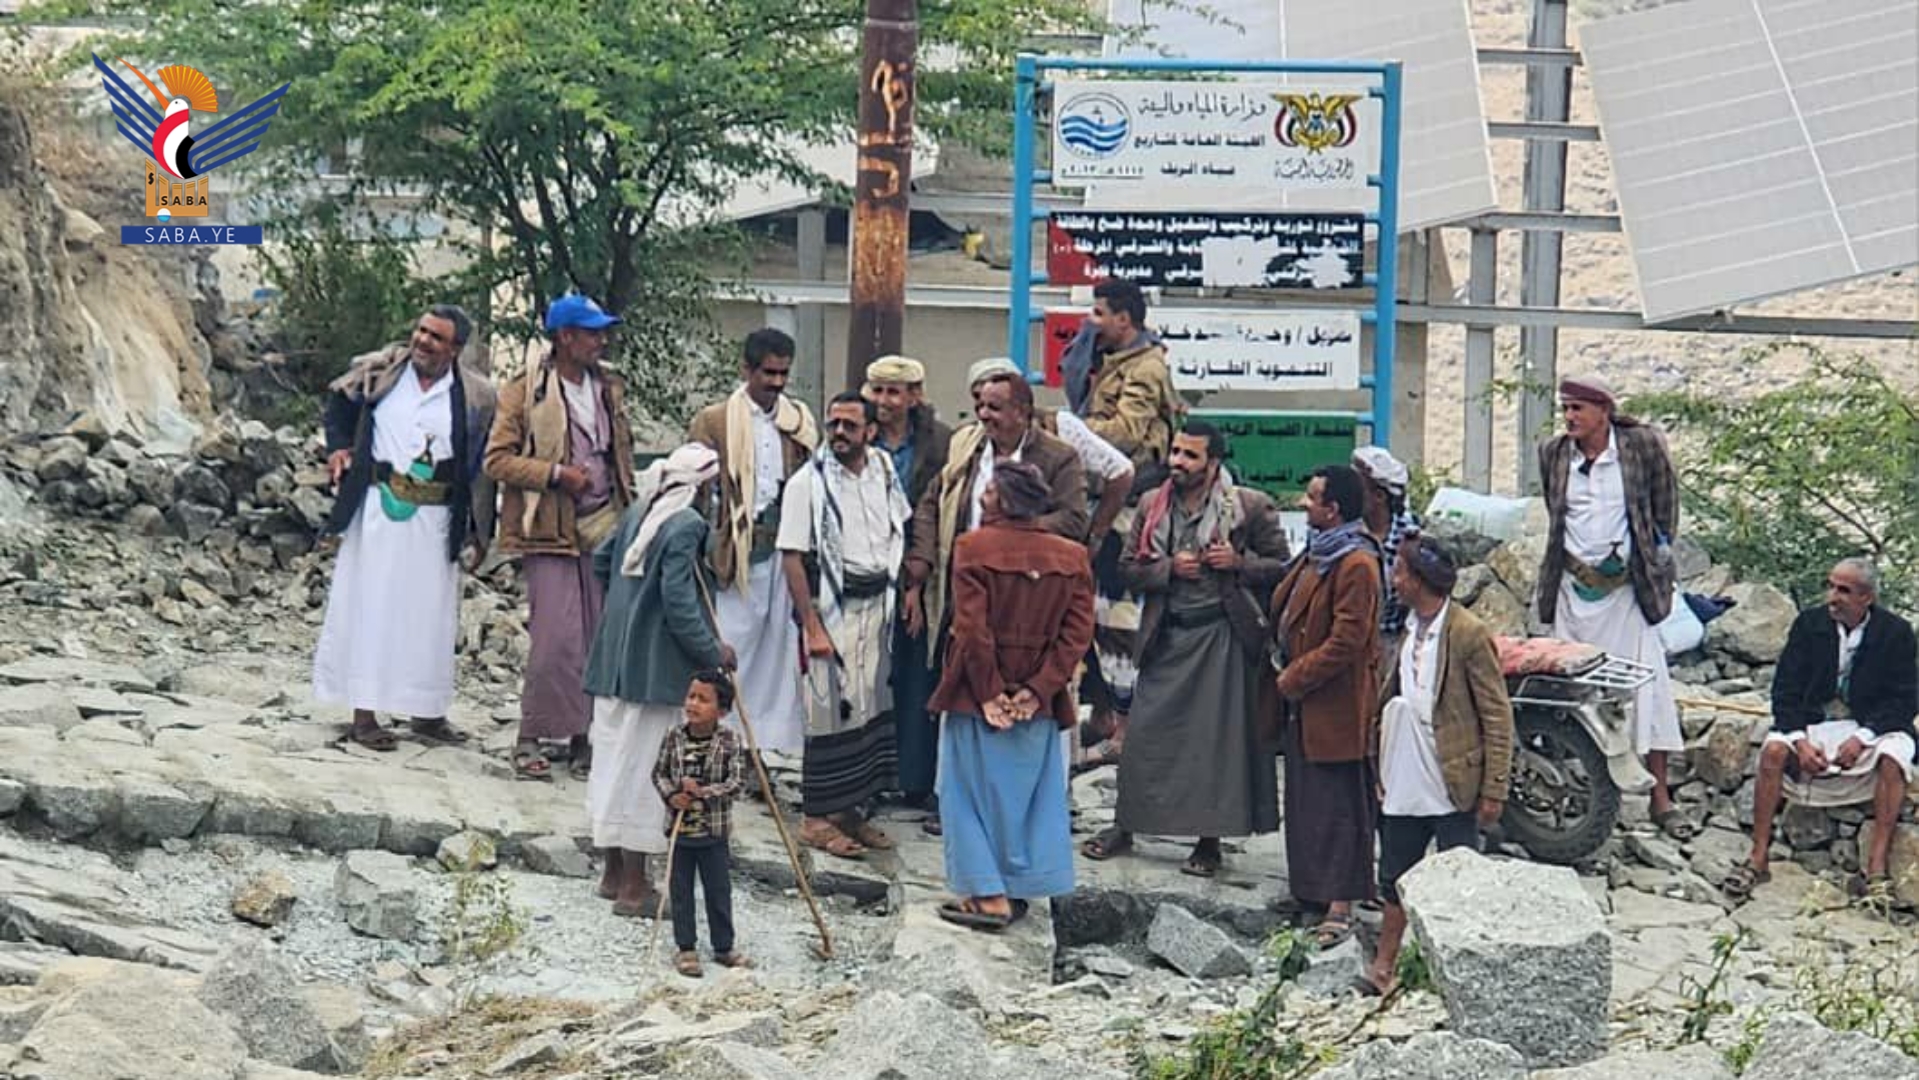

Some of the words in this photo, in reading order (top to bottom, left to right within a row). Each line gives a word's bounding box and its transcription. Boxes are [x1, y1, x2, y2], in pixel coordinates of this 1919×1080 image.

[1137, 91, 1184, 118] والبيئة
[1187, 92, 1218, 120] المياه
[1222, 92, 1267, 121] وزارة
[1133, 132, 1177, 149] لمشاريع
[1182, 131, 1221, 146] العامة
[1226, 133, 1265, 147] الهيئة
[1160, 160, 1198, 177] الريف
[1201, 162, 1235, 175] مياه
[1057, 215, 1095, 231] بالطاقة
[1098, 217, 1124, 232] ضخ
[1127, 216, 1162, 232] وحدة
[1166, 217, 1216, 232] وتشغيل
[1220, 217, 1269, 233] وتركيب
[1274, 219, 1313, 234] توريد
[1317, 219, 1358, 234] مشروع
[1113, 263, 1153, 280] مديرية
[1178, 358, 1251, 379] الطارئة
[1256, 360, 1333, 380] التنموية
